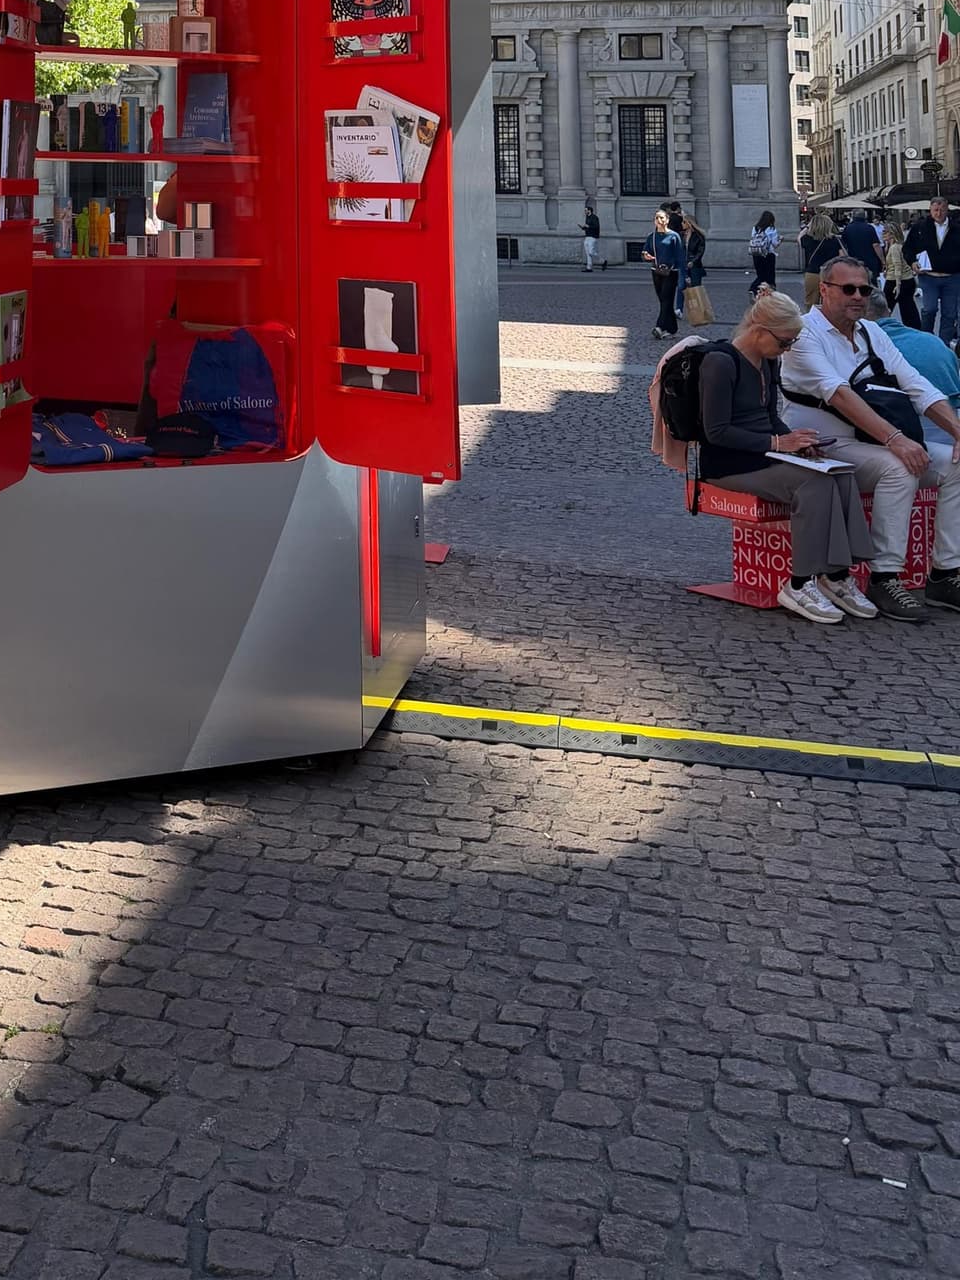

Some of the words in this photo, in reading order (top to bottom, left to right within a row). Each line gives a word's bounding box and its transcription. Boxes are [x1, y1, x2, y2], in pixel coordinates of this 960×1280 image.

[97, 103, 107, 113] 13
[336, 132, 377, 142] INVENTARIO
[220, 396, 233, 410] of
[233, 395, 273, 409] Salone
[710, 495, 748, 515] Salone
[750, 503, 765, 518] del
[733, 526, 793, 552] DESIGN
[911, 506, 923, 568] KIOSK
